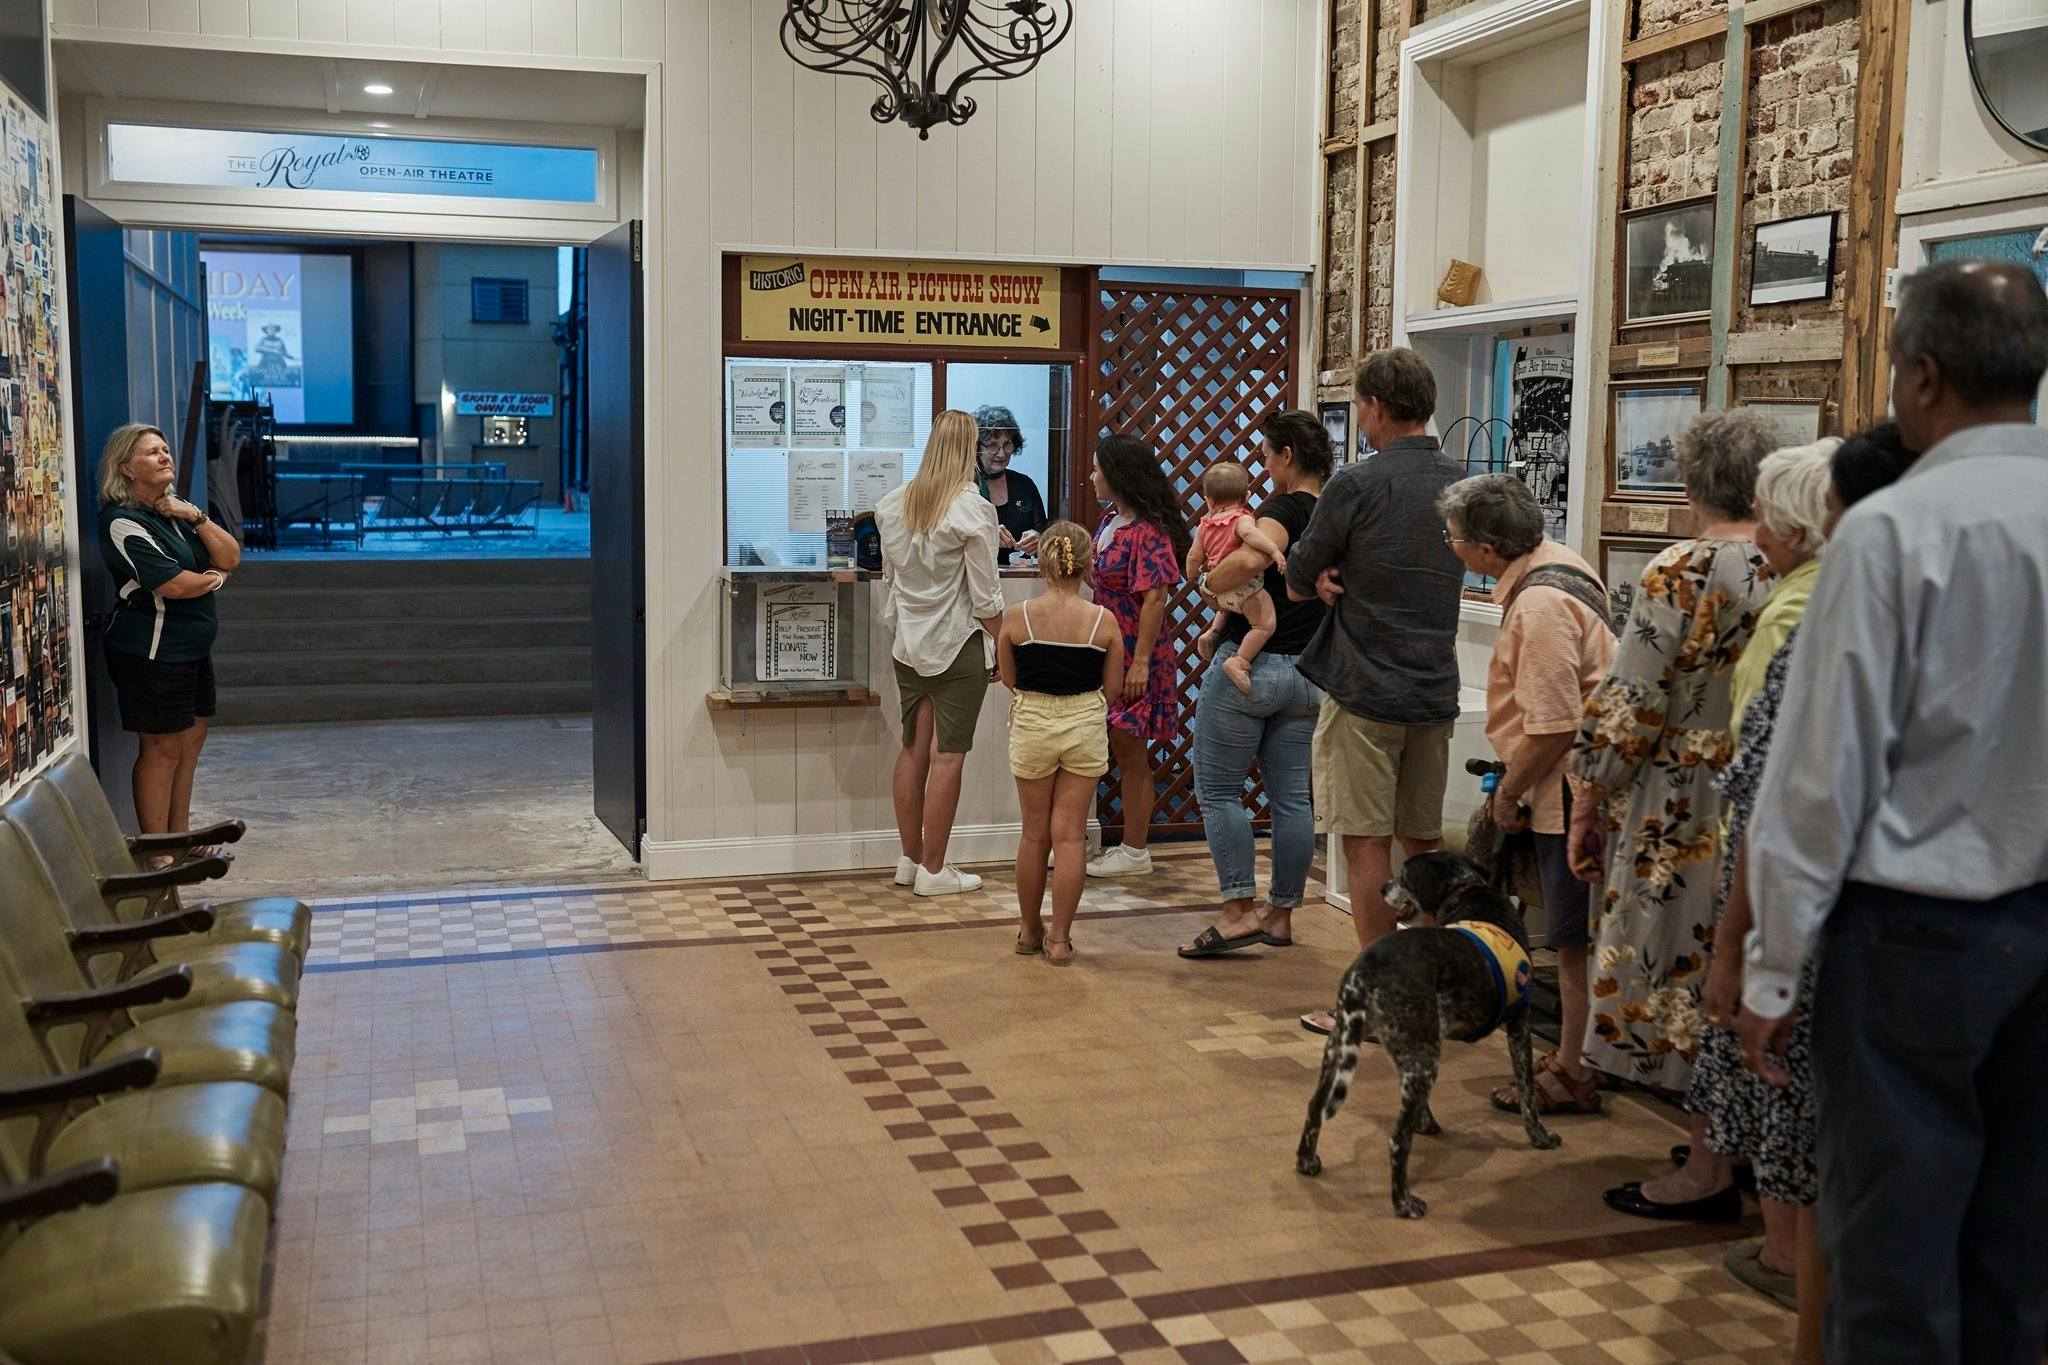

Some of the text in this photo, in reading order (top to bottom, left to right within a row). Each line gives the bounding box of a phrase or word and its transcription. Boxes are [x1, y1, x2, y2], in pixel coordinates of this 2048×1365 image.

[227, 144, 352, 190] THE Royal
[359, 166, 494, 182] OPEN-AIR THEATRE
[208, 270, 295, 301] IDAY
[752, 267, 803, 290] HISTORIC
[809, 268, 1044, 305] OPEN AIR PICTURE SHOW
[788, 307, 1023, 338] NIGHT-TIME ENTRANCE
[461, 394, 498, 403] SKATE
[501, 395, 517, 403] AT
[474, 404, 536, 413] OWN RISK
[778, 625, 822, 633] HELP PRESERVE
[779, 642, 808, 652] DONATE
[799, 653, 818, 661] NOW
